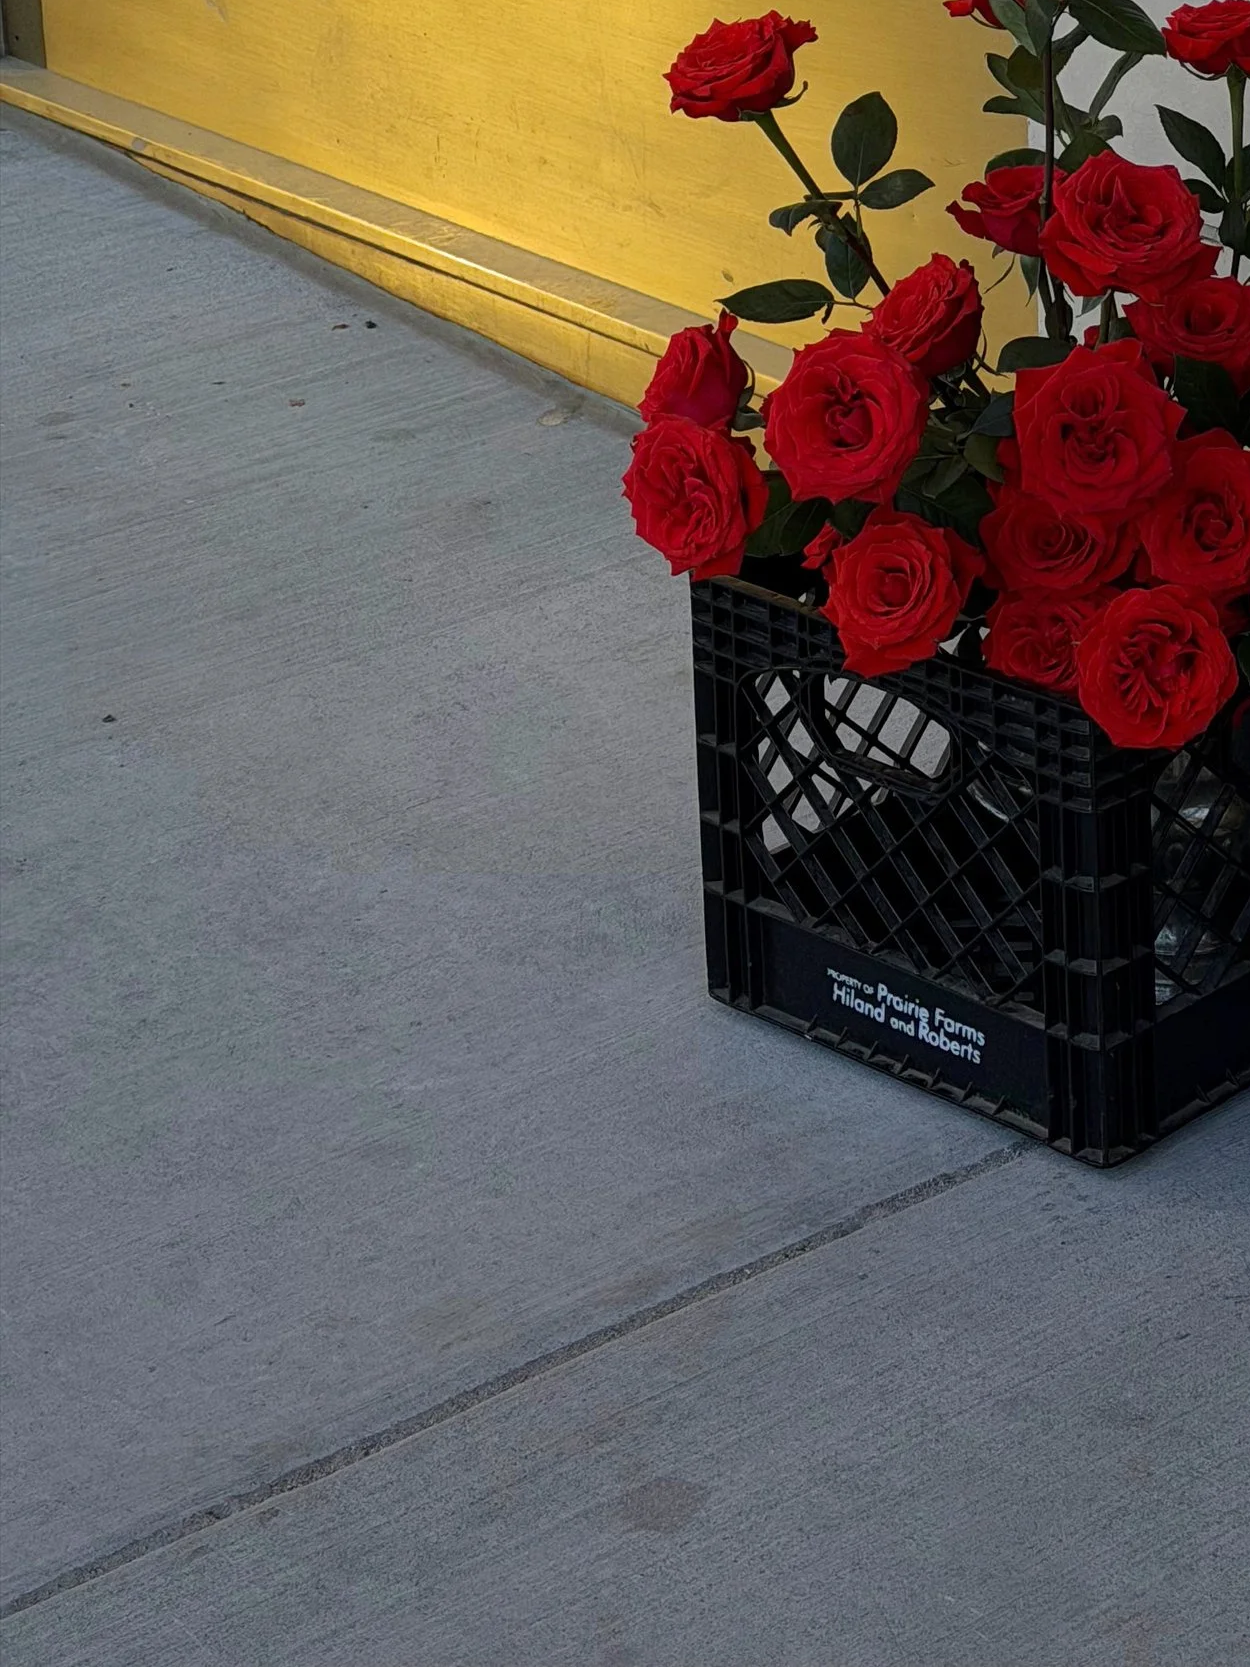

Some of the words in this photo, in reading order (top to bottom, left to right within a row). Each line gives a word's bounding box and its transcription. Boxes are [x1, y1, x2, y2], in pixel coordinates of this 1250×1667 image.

[832, 982, 886, 1023] Hiland
[889, 1016, 915, 1037] and
[918, 1021, 981, 1065] Roberts
[877, 983, 930, 1023] Prairie
[934, 1007, 986, 1047] Farms
